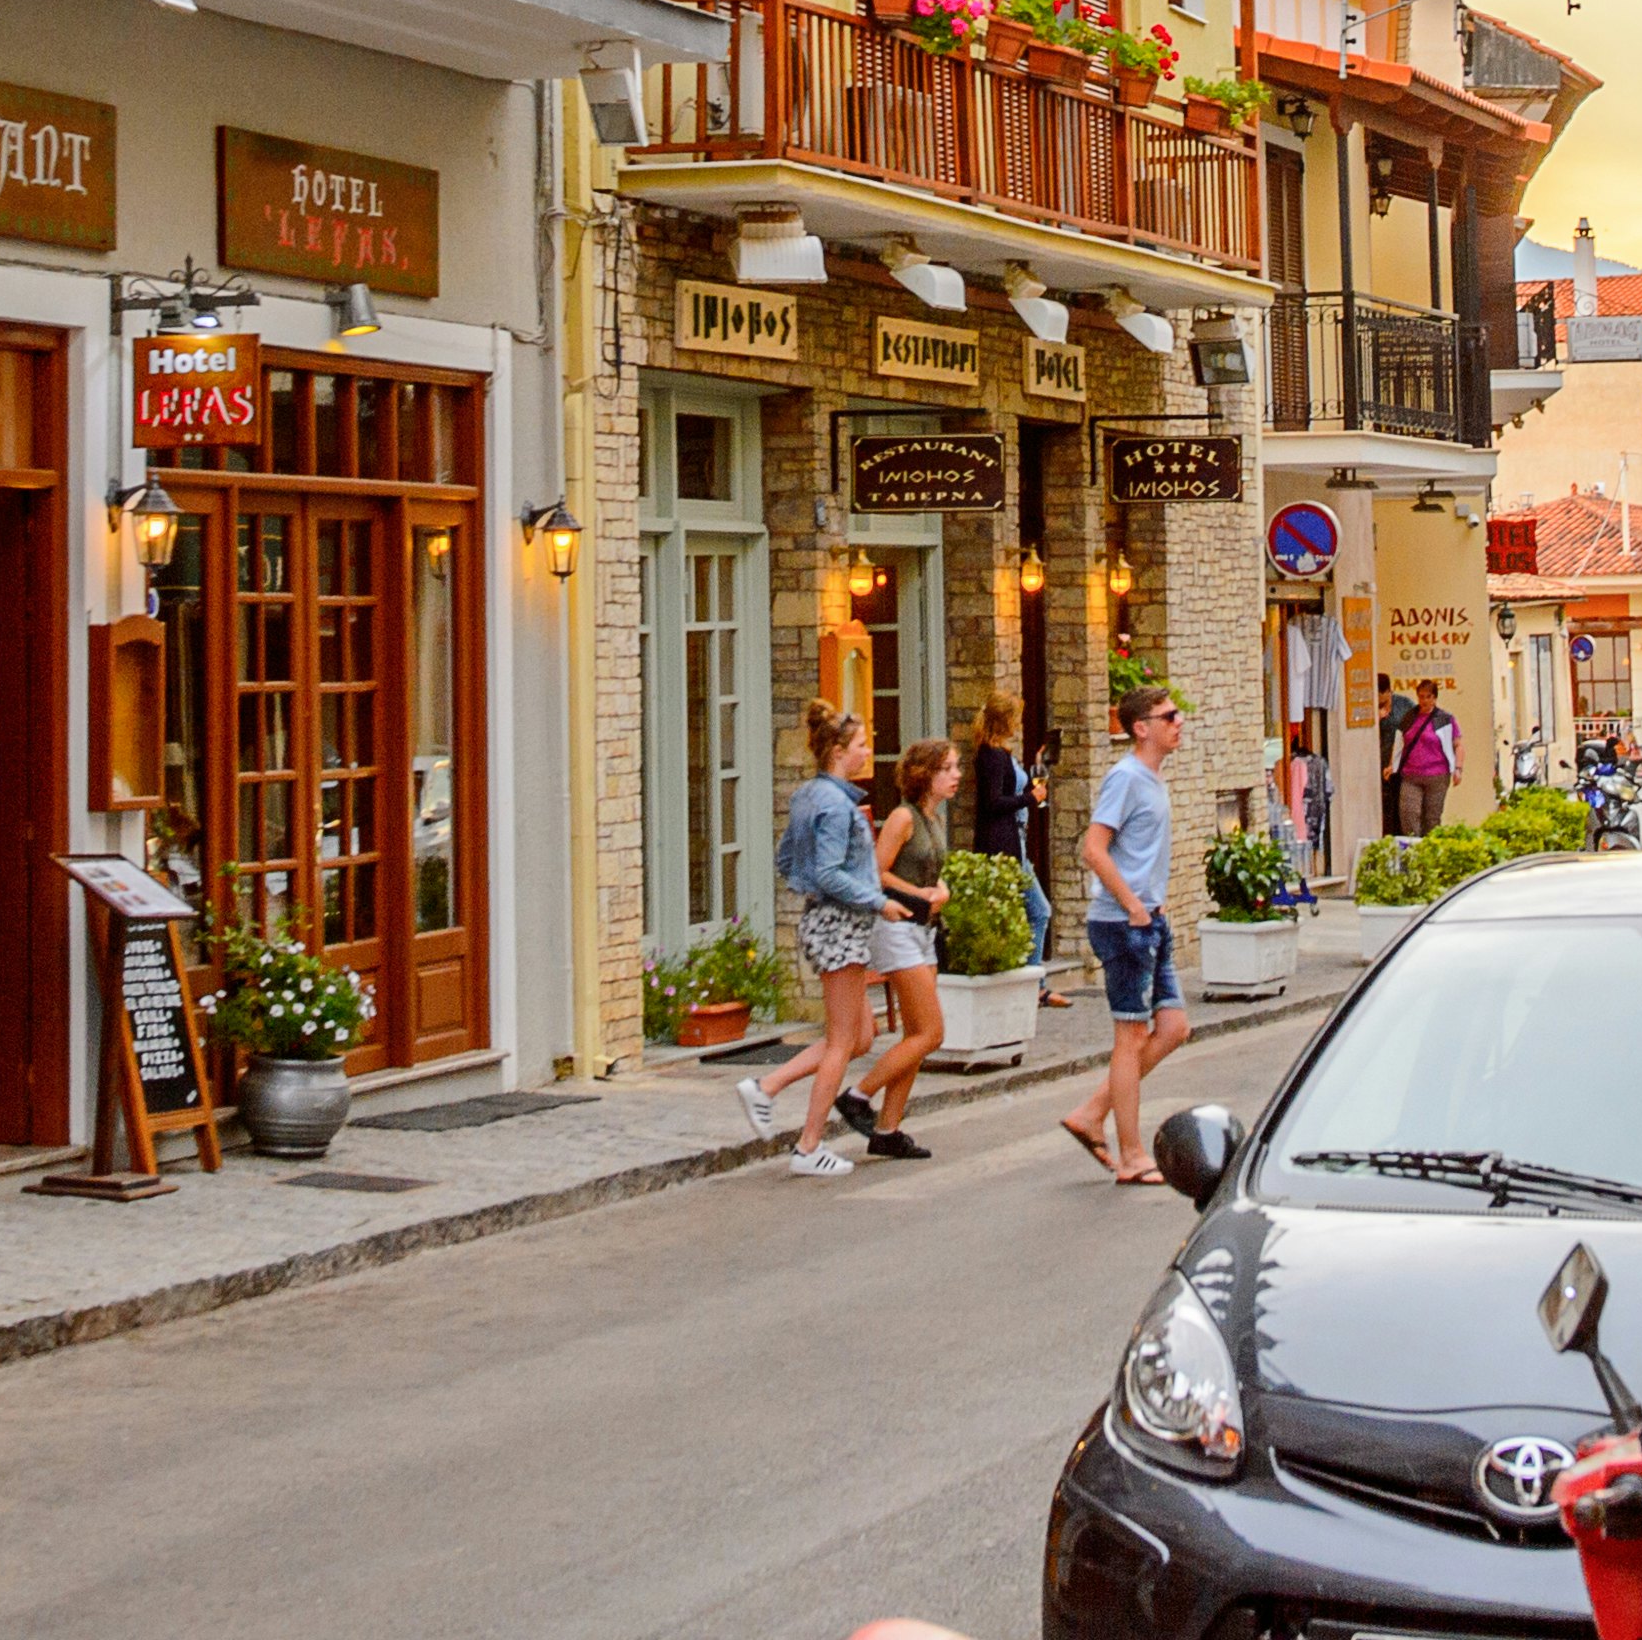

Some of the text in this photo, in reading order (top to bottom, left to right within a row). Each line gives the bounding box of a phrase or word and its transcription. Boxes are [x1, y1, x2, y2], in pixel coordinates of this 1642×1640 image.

[292, 164, 384, 217] HOTEL
[148, 346, 236, 375] Hotel
[1036, 350, 1083, 392] HOTEL
[136, 385, 254, 427] LEFAS
[859, 441, 998, 471] RESTAURANT
[1124, 442, 1219, 467] HOTEL
[1390, 607, 1469, 627] ADONIS
[1388, 630, 1471, 646] JEWELERY
[1399, 648, 1453, 661] GOLD
[1393, 677, 1456, 691] AMER
